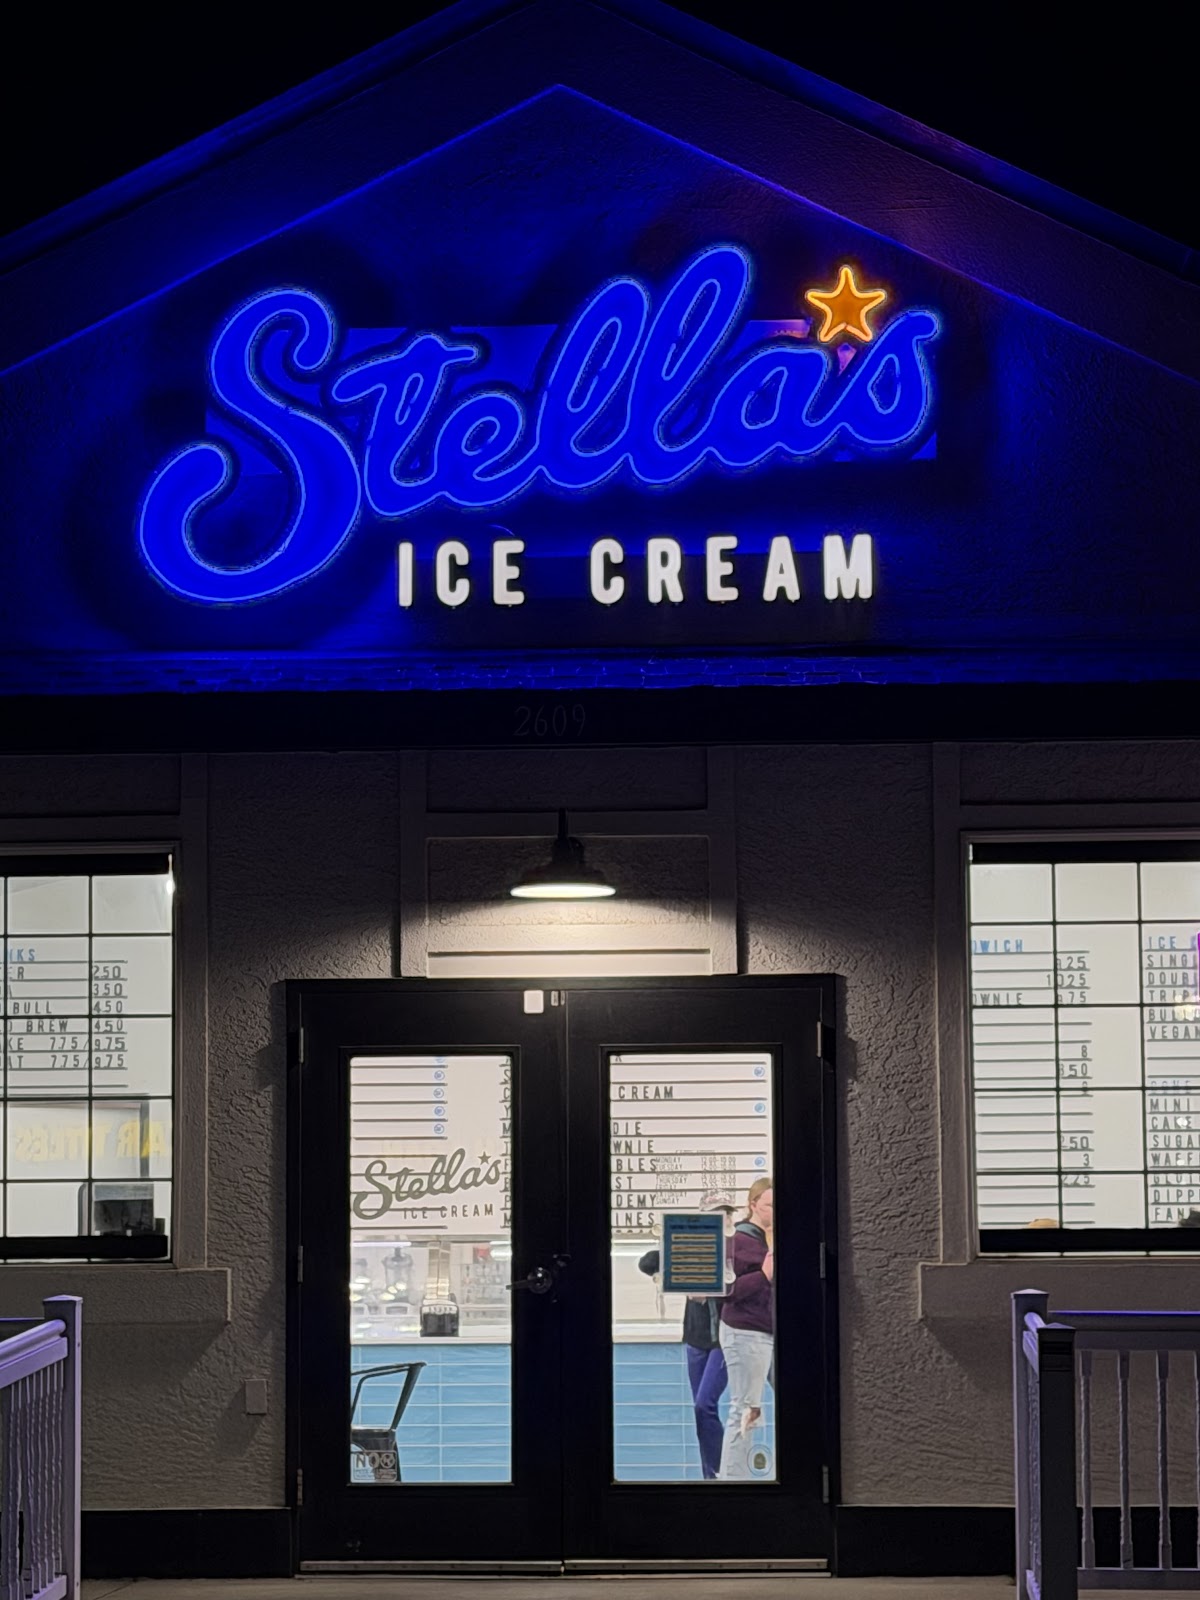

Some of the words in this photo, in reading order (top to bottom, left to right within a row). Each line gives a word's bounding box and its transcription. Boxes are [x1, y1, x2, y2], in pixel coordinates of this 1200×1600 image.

[398, 538, 526, 608] ICE
[589, 532, 875, 605] CREAM
[512, 703, 587, 737] 2609
[1148, 936, 1176, 949] ICE
[12, 1000, 52, 1014] BULL
[26, 1019, 68, 1033] BREW
[618, 1085, 674, 1099] CREAM
[1150, 1098, 1190, 1111] MINI
[613, 1121, 643, 1135] DIE
[613, 1139, 654, 1154] WNIE
[615, 1176, 633, 1190] ST
[616, 1193, 656, 1207] DEMY
[403, 1207, 428, 1219] ICE
[440, 1203, 494, 1218] CREAM
[615, 1212, 655, 1227] INES
